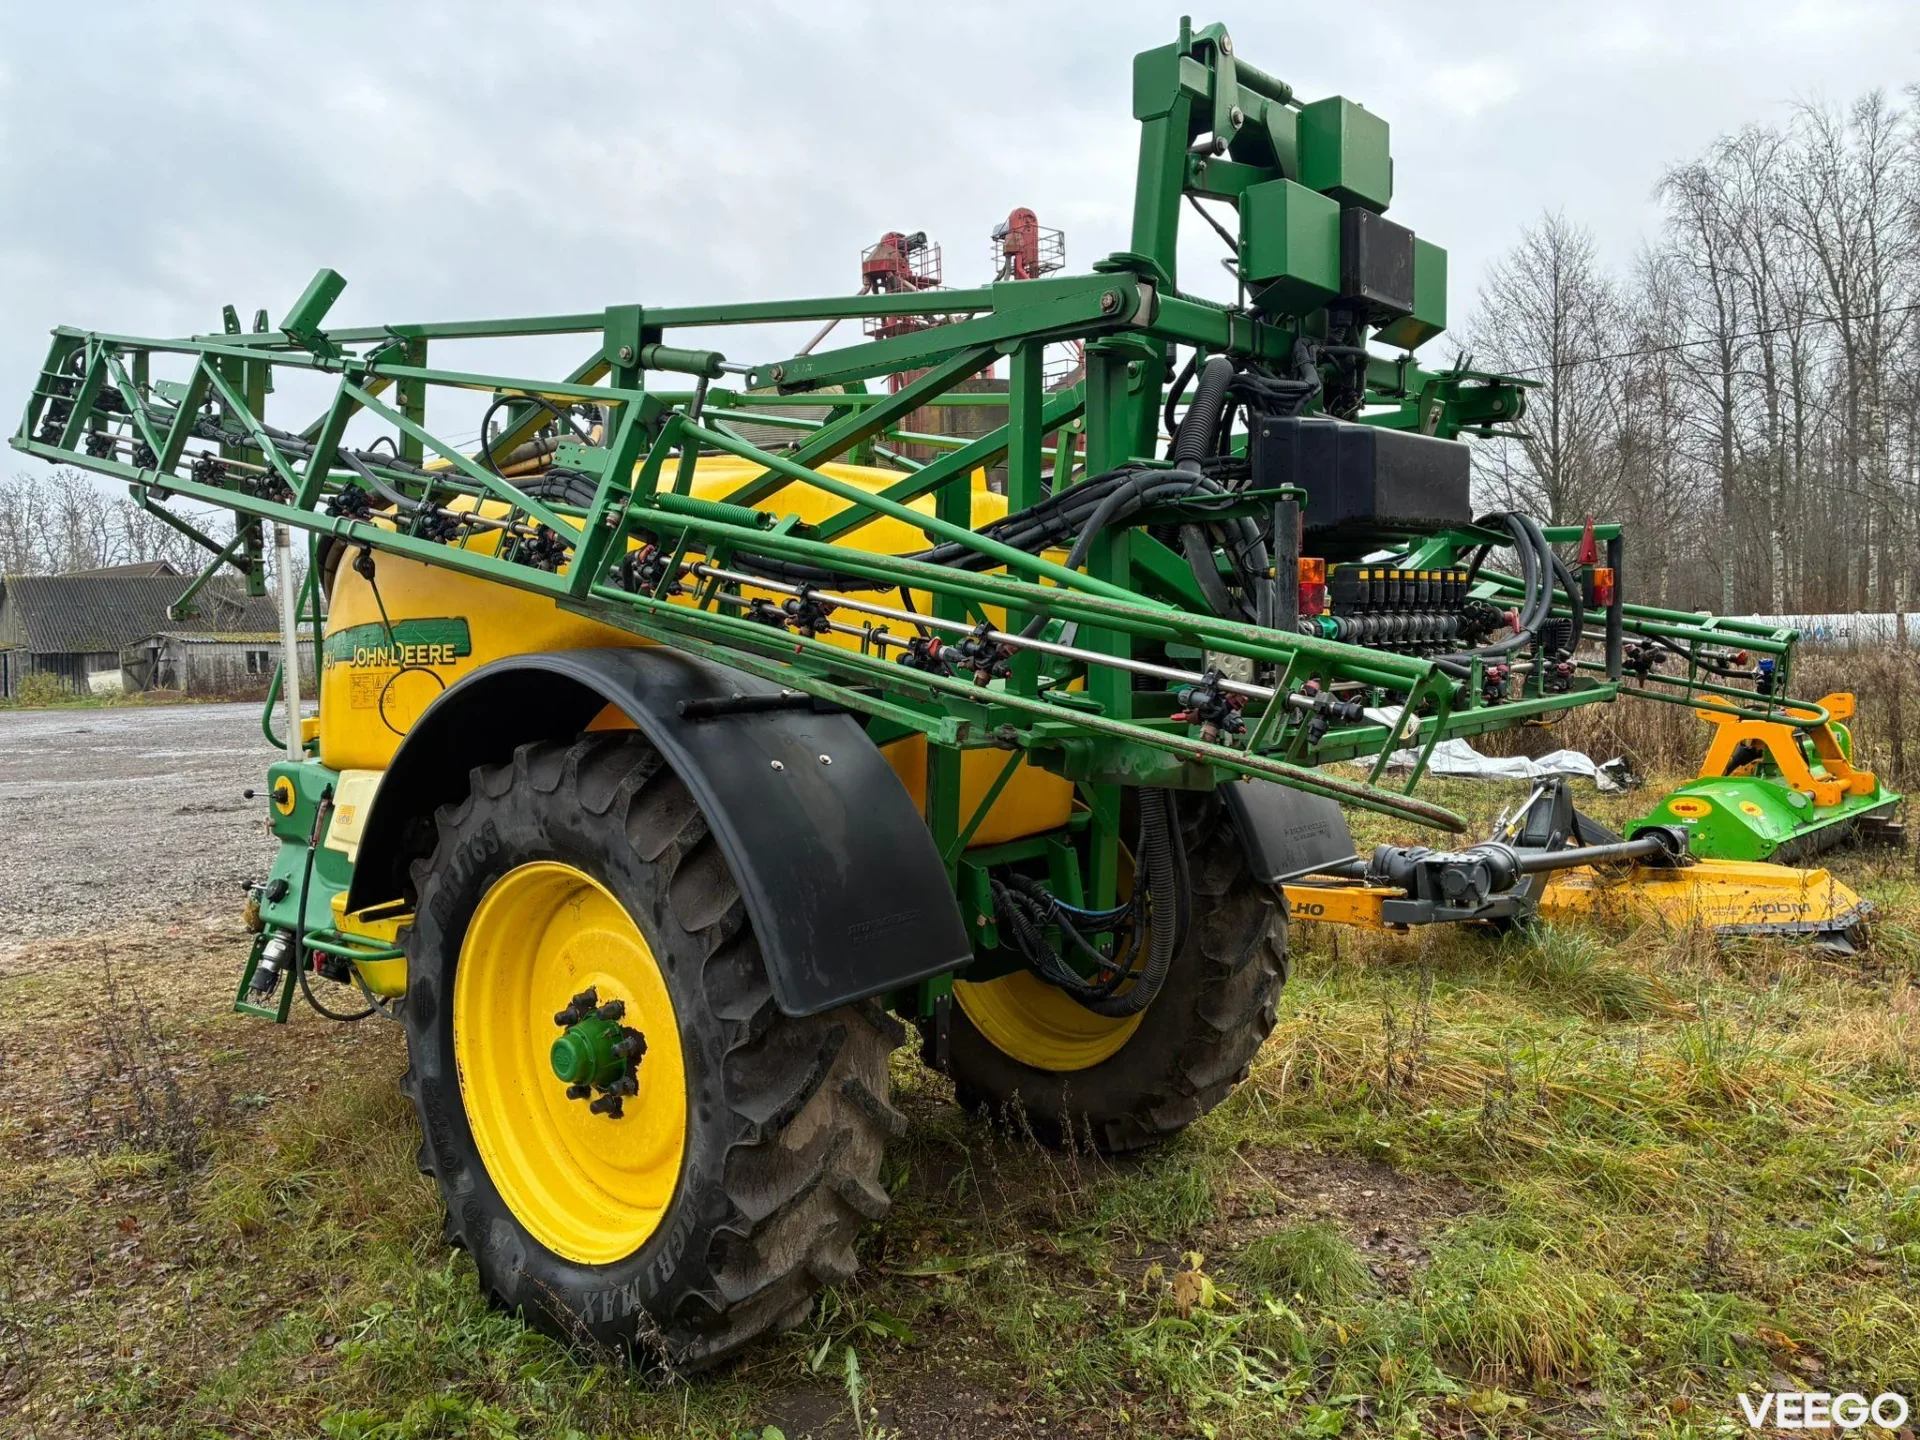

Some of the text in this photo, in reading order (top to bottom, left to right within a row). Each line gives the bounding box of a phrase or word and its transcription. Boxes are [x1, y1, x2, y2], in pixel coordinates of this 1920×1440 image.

[350, 642, 456, 667] JOHN DEERE
[1290, 901, 1325, 916] LHO
[580, 1203, 698, 1324] AGRIMAX
